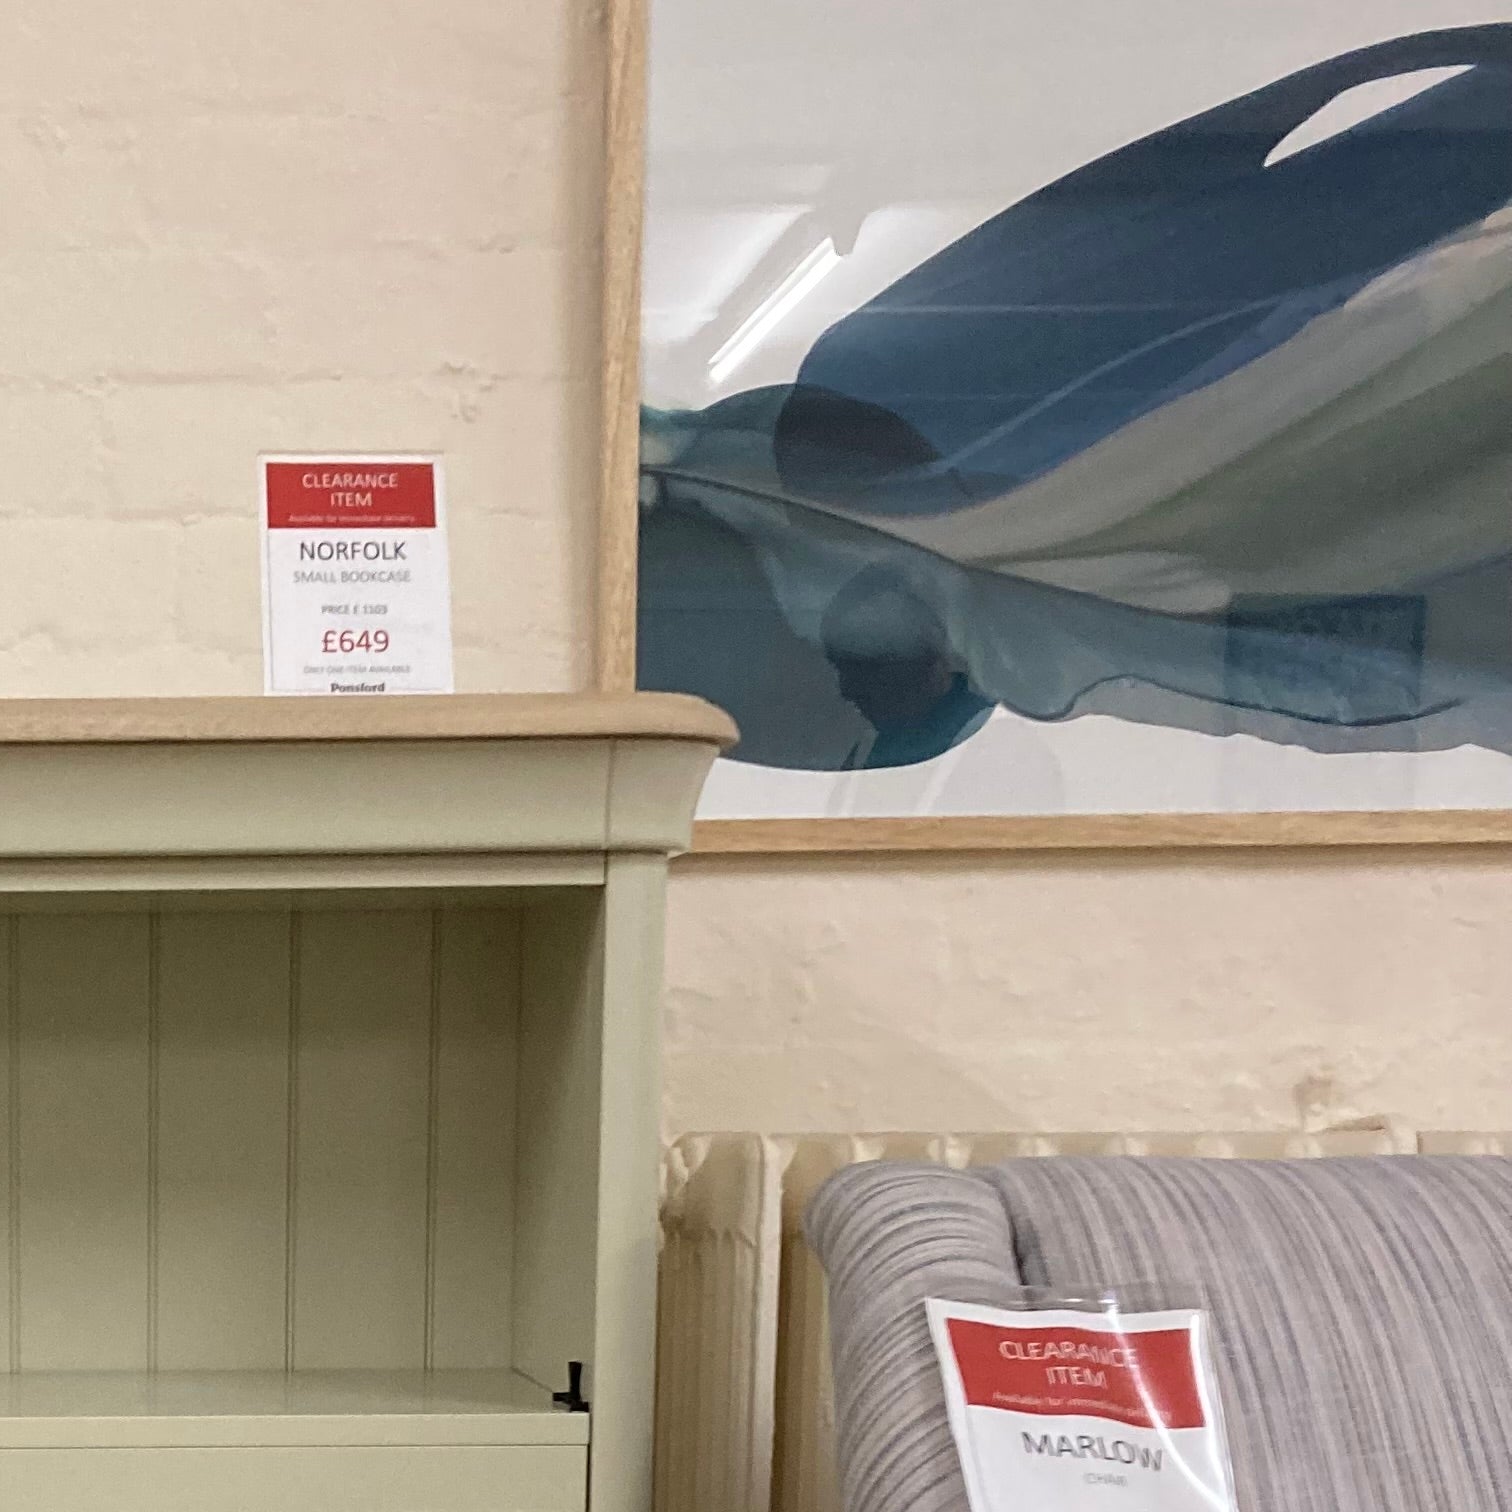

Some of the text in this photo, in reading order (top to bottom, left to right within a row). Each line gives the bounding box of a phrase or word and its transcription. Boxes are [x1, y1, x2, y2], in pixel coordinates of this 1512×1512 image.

[302, 472, 399, 489] CLEARANCE
[331, 491, 373, 507] ITEM
[299, 541, 407, 560] NORFOLK
[293, 570, 412, 583] SMALL BOOKCASE
[321, 604, 350, 615] PRICE
[322, 628, 390, 654] £649
[330, 682, 386, 693] Ponsford
[998, 1340, 1140, 1370] CLEARANCE
[1045, 1365, 1109, 1390] ITEM
[1020, 1431, 1163, 1471] MARLOW
